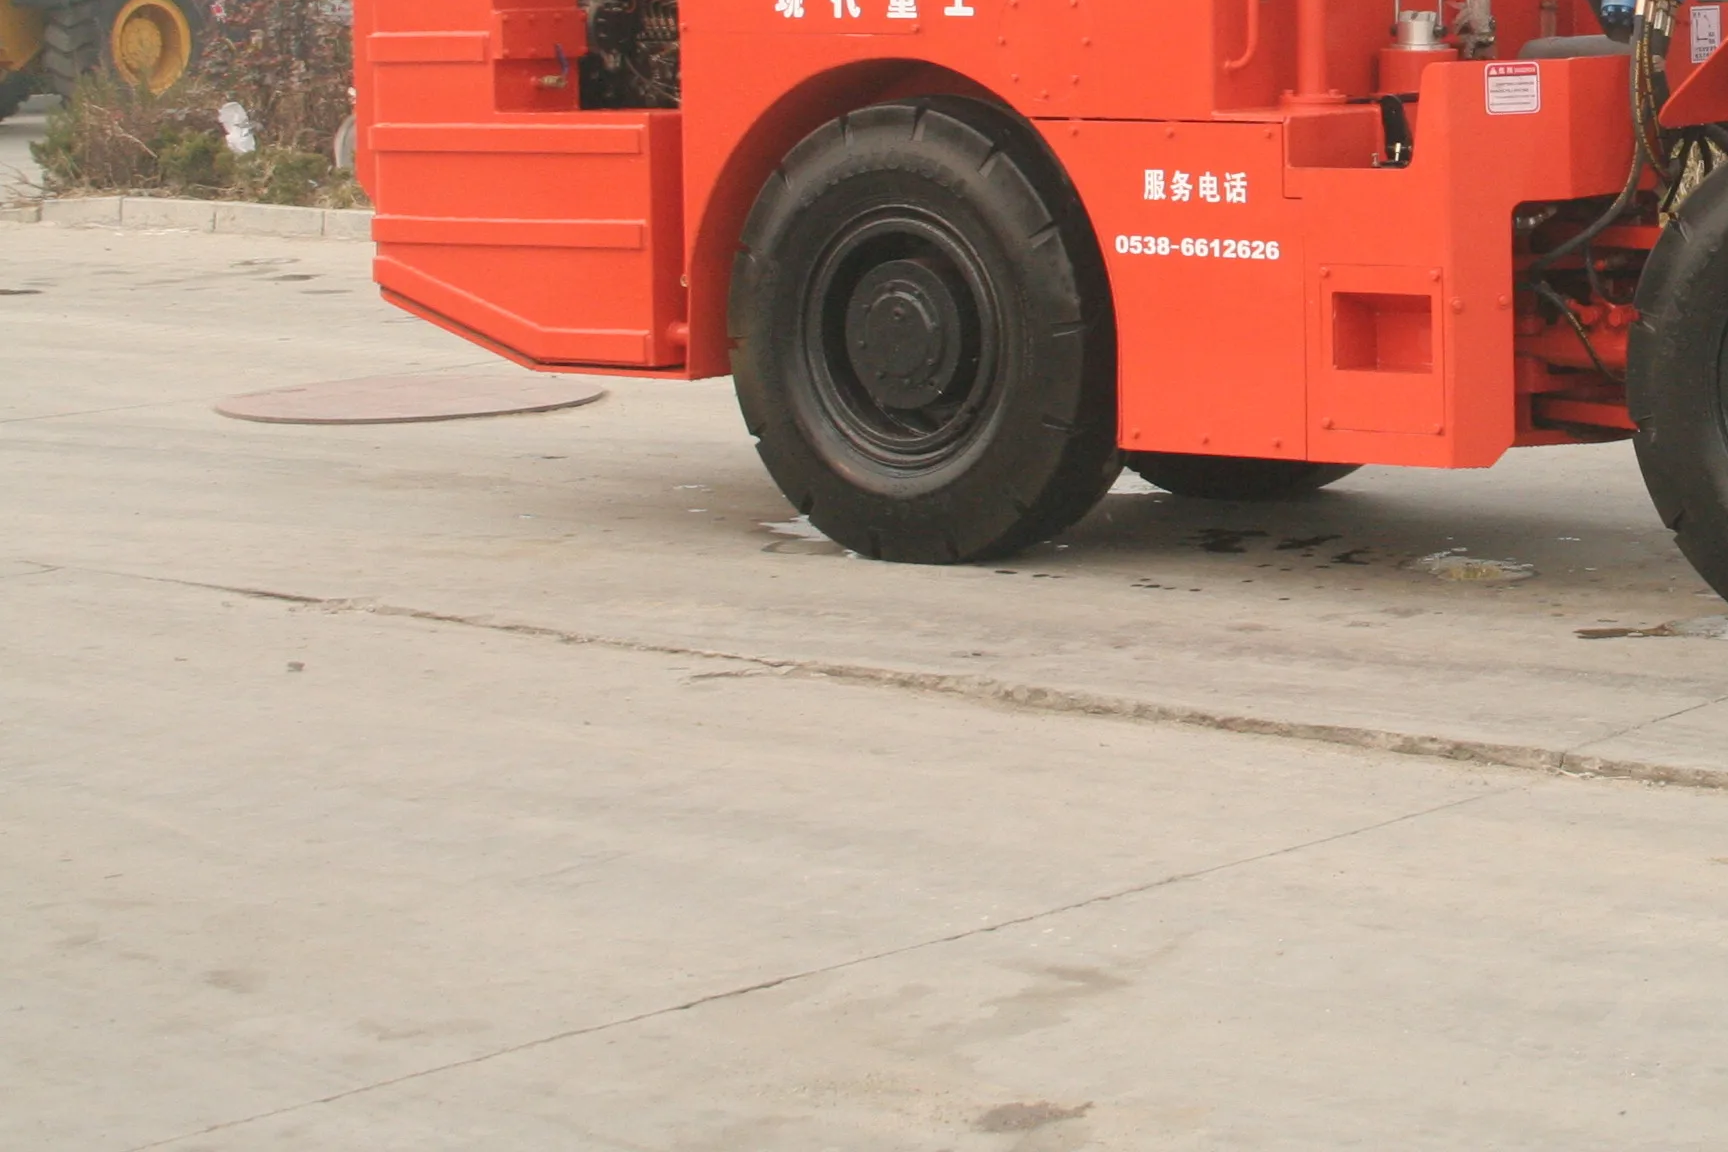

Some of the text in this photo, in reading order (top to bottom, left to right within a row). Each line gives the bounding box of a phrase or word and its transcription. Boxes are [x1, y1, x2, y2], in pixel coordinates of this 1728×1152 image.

[1143, 169, 1248, 203] 服务电话
[1114, 234, 1280, 260] 0538-6612626
